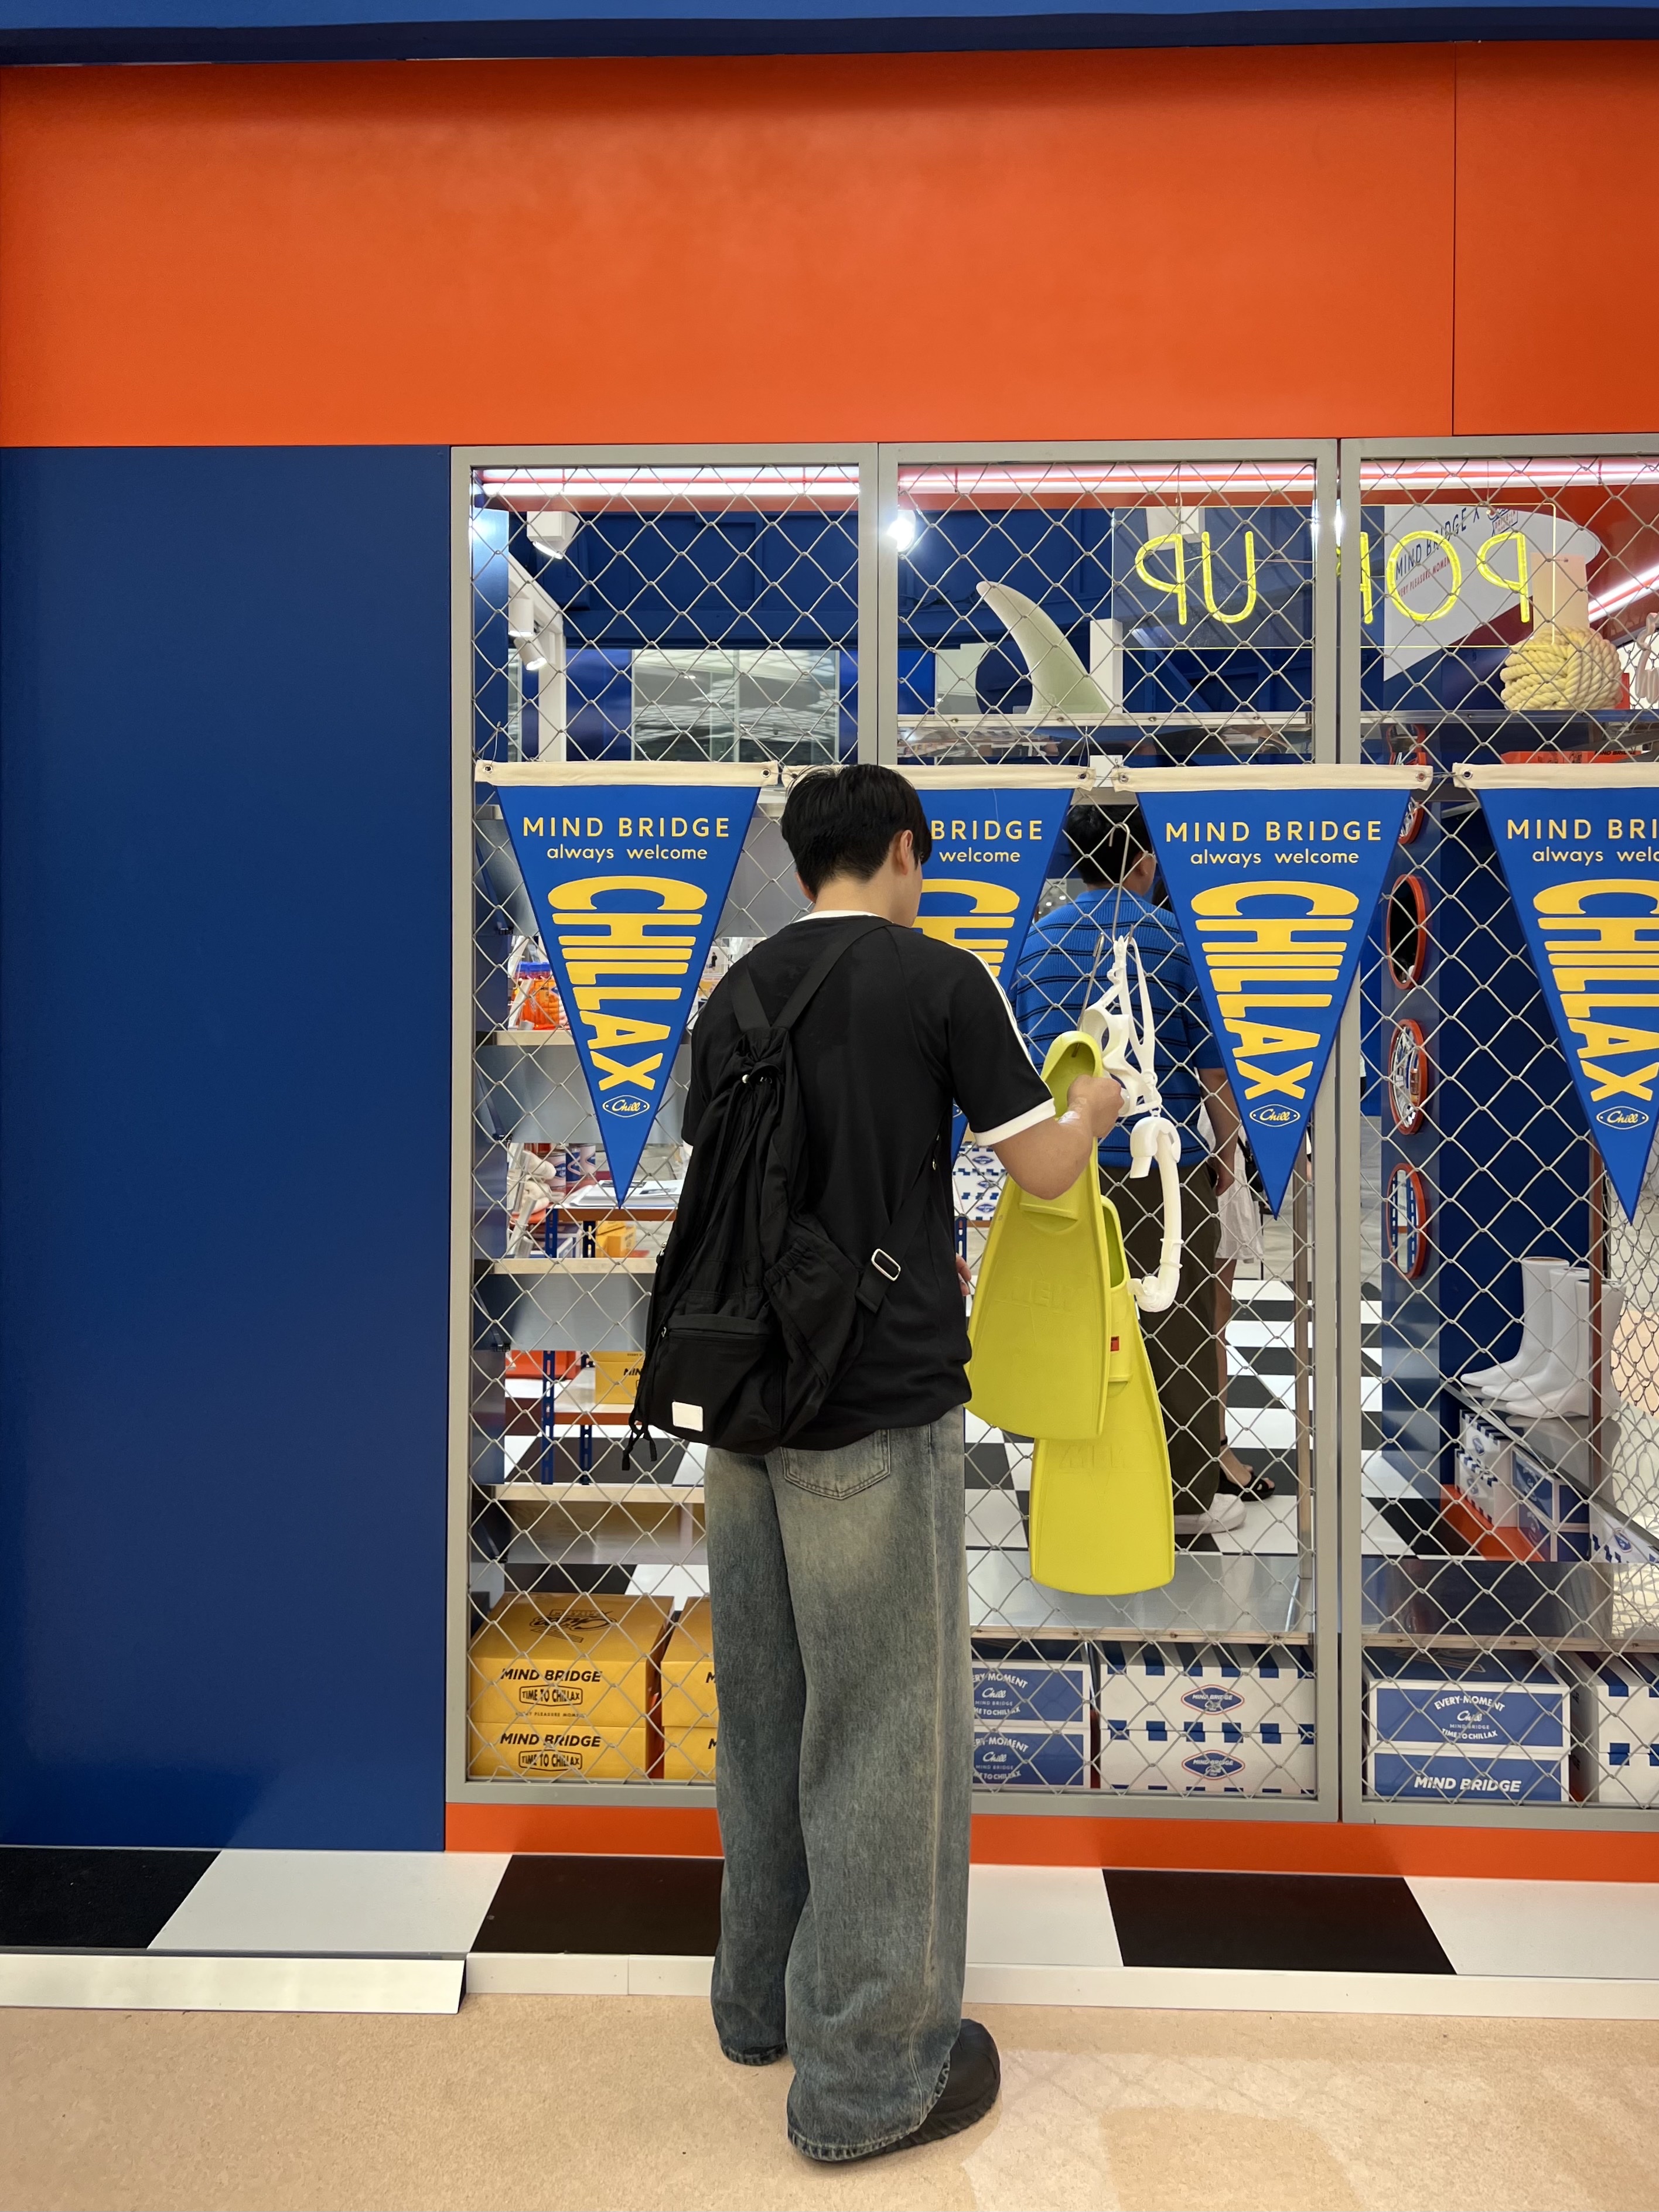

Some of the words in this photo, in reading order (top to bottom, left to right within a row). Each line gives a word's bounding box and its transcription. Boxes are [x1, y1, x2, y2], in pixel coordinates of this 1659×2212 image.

[1395, 543, 1422, 580] MIND
[1409, 569, 1431, 591] PLEASURE
[1432, 556, 1450, 575] MOMEN
[523, 817, 603, 837] MIND
[619, 818, 729, 837] BRIDGE
[931, 820, 1042, 840] BRIDGE
[1166, 822, 1250, 842] MIND
[1265, 820, 1382, 842] BRIDGE
[1507, 819, 1592, 839] MIND
[1608, 819, 1658, 839] BRI
[547, 844, 614, 863] always
[627, 844, 708, 859] welcome
[939, 847, 1020, 863] welcome
[1190, 849, 1261, 869] always
[1275, 848, 1359, 864] welcome
[1532, 846, 1604, 866] always
[548, 875, 708, 1091] CHILLAX
[1190, 880, 1360, 1100] CHILLAX
[1532, 878, 1659, 1102] CHILLAX
[612, 1099, 641, 1112] Chill
[1259, 1108, 1291, 1121] Chill
[1607, 1110, 1638, 1123] Chill
[500, 1669, 540, 1680] MIND
[544, 1670, 602, 1682] BRIDGE
[522, 1690, 538, 1701] TIME
[540, 1689, 550, 1702] TO
[552, 1689, 580, 1702] CHILLAX
[982, 1687, 1006, 1698] Chill
[500, 1733, 540, 1745] MIND
[544, 1734, 602, 1747] BRIDGE
[1468, 1730, 1498, 1740] CHILLAX
[540, 1753, 549, 1767] TO
[982, 1751, 1007, 1762] Chill
[1414, 1776, 1456, 1790] MIND
[1460, 1778, 1522, 1793] BRIDGE
